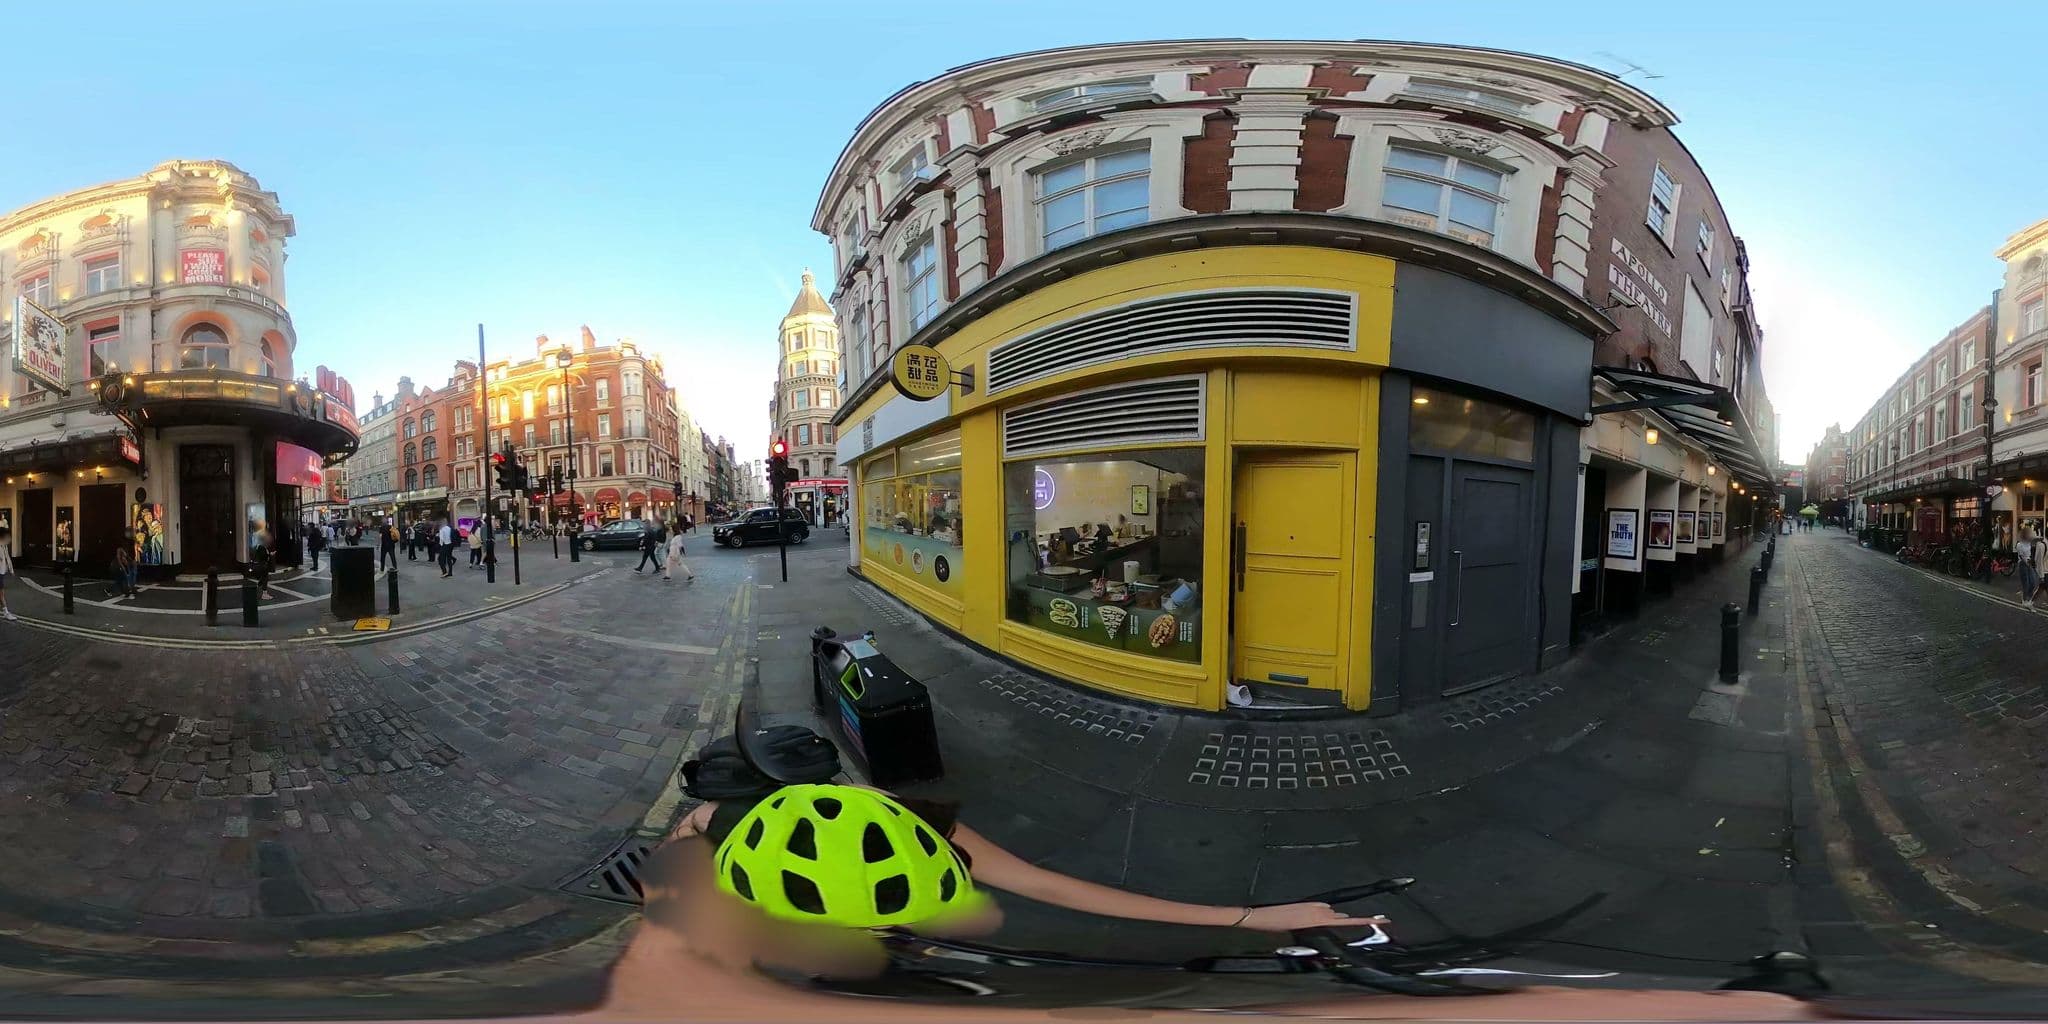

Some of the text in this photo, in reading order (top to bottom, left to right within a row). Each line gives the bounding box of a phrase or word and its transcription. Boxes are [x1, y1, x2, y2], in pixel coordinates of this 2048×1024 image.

[187, 252, 219, 260] PLEASE
[1616, 246, 1665, 300] APOLLO
[185, 275, 224, 284] MORE!
[1613, 266, 1672, 337] THEATRE
[29, 350, 61, 379] OLIVER!
[1616, 523, 1629, 532] THE
[1611, 530, 1633, 540] TRUTH
